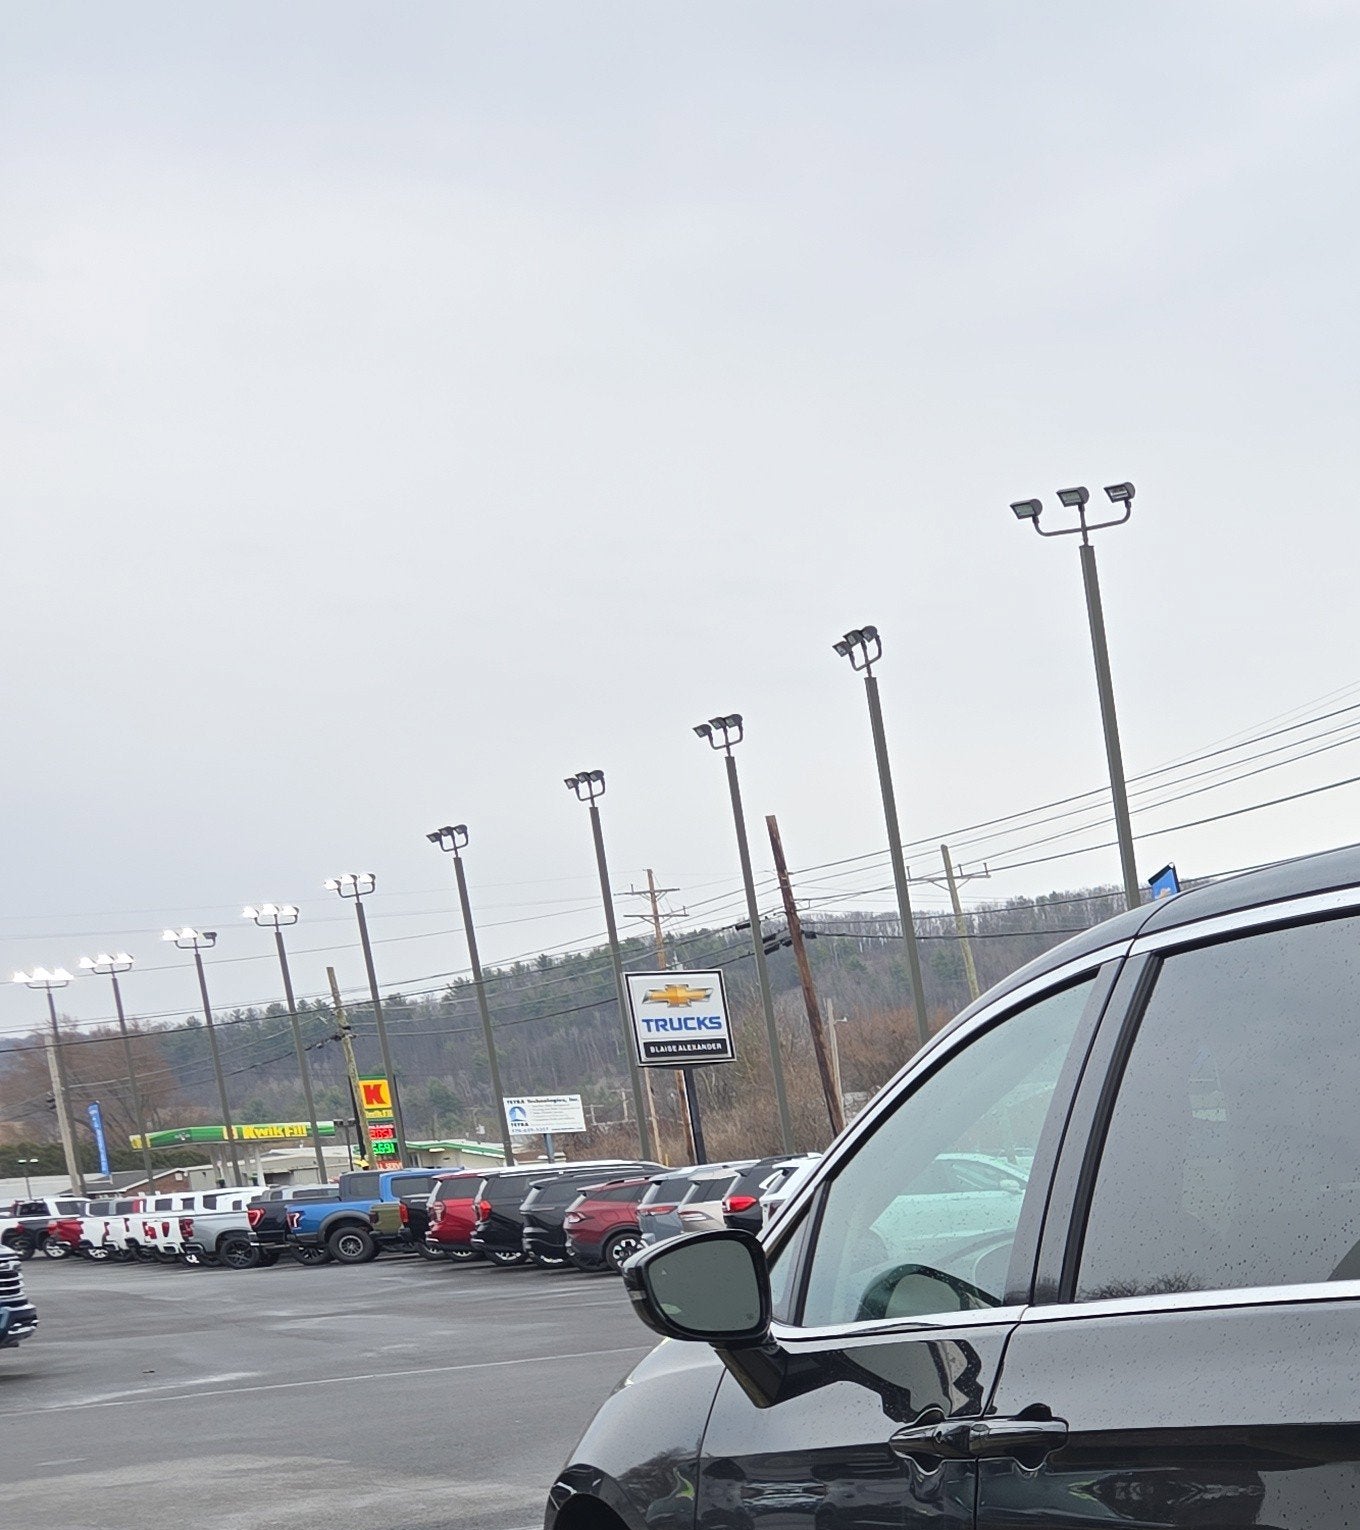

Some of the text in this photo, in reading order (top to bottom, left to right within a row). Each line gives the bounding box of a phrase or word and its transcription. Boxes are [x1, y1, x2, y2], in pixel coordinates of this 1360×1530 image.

[642, 1016, 722, 1033] TRUCKS
[650, 1042, 722, 1053] BLAISE ALEXANDER
[363, 1084, 386, 1105] K
[243, 1124, 307, 1139] Kwik Fill
